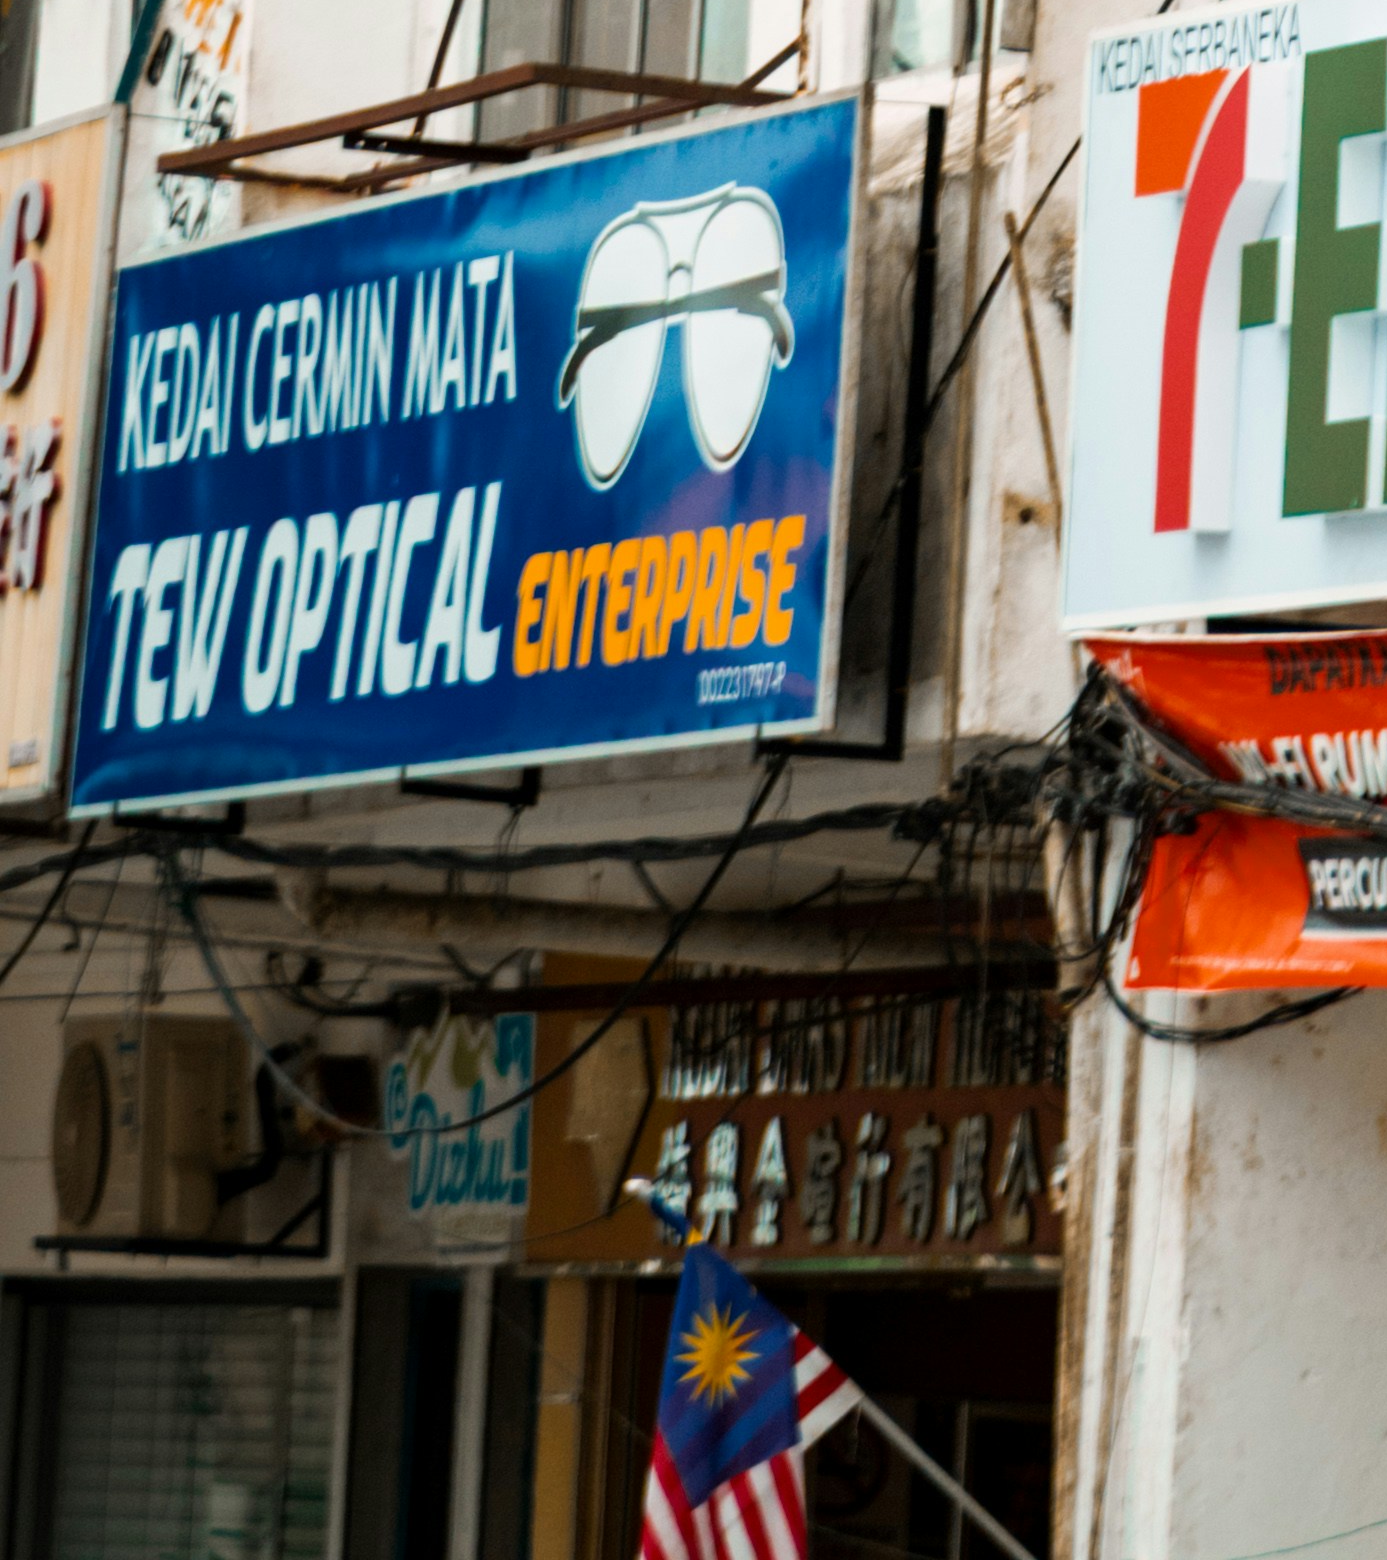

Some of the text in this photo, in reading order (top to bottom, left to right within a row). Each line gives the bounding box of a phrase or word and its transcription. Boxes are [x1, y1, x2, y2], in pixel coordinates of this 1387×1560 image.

[1099, 3, 1303, 92] KEDAI SERBANEKA
[117, 249, 517, 474] KEDAI CERMIN MATA
[104, 526, 250, 732] TEW
[243, 482, 504, 715] OPTICAL
[512, 514, 807, 678] ENTERPRISE
